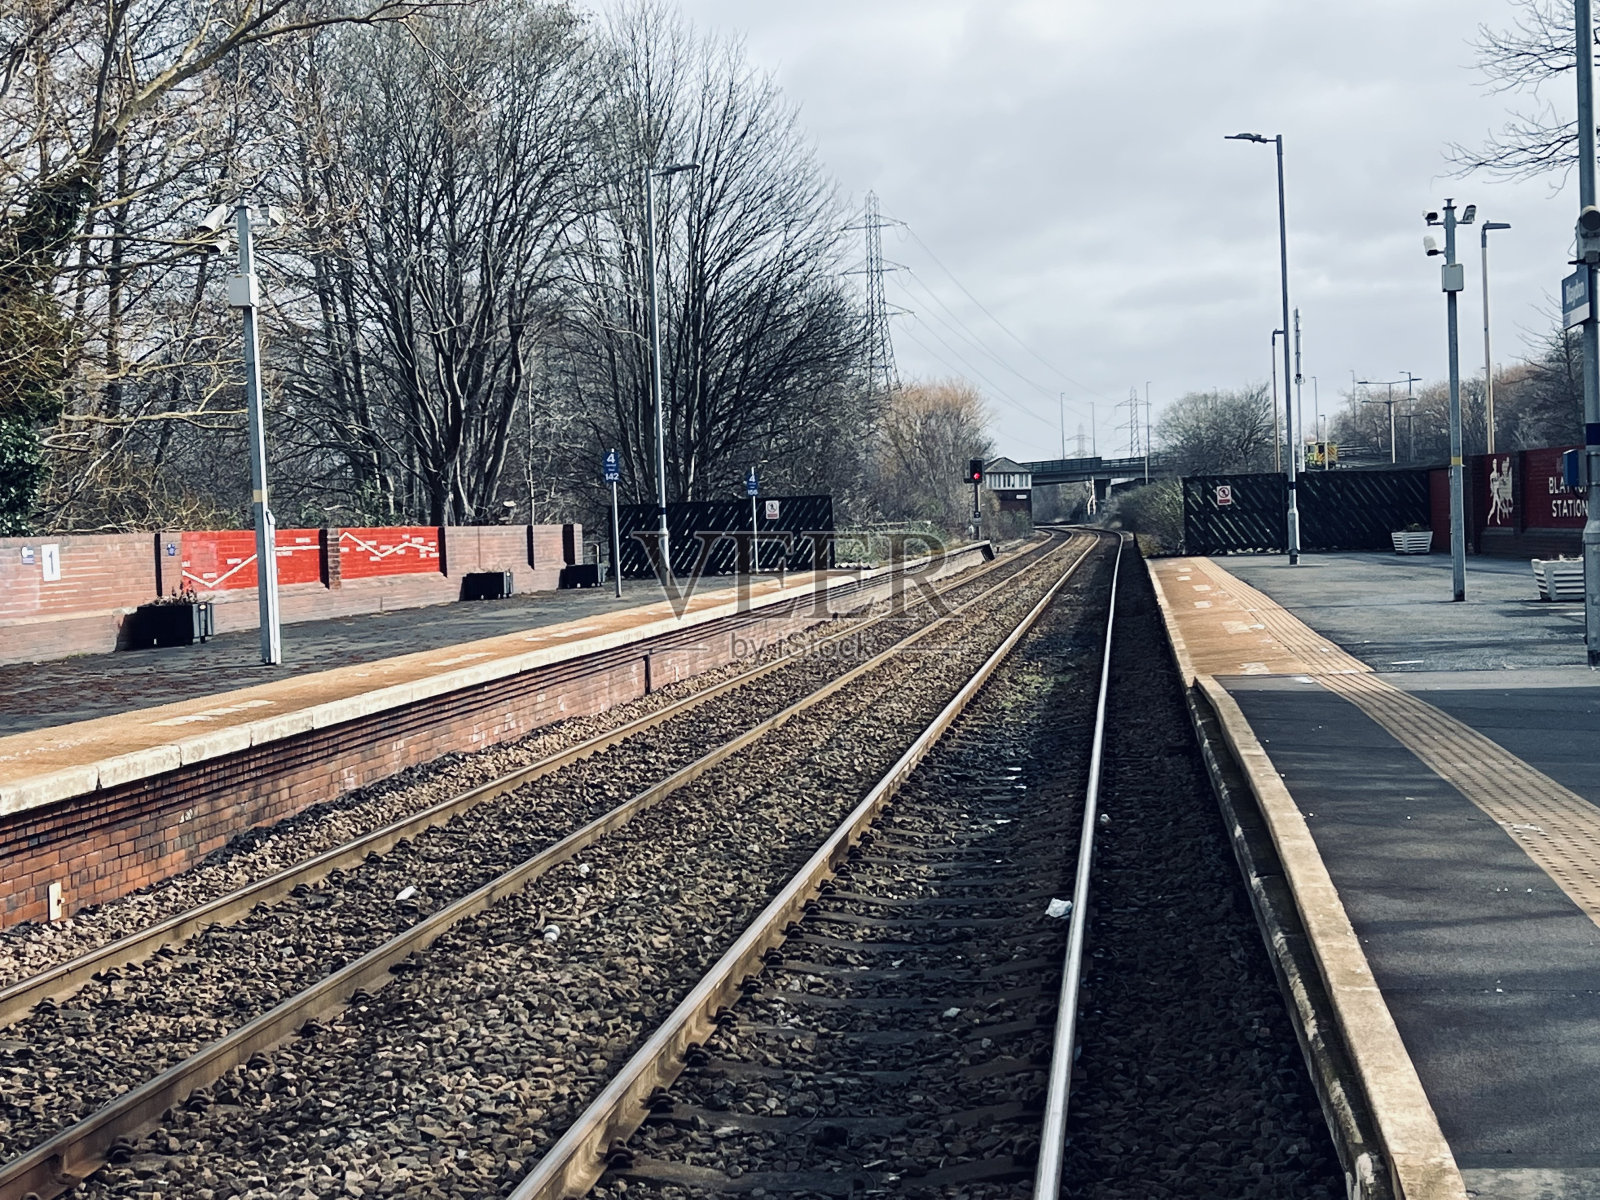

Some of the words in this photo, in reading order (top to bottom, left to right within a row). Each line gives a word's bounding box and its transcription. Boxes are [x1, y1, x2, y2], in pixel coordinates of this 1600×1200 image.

[606, 453, 616, 464] 4
[605, 472, 620, 481] 142
[1551, 499, 1589, 518] STATION
[48, 550, 55, 575] 1
